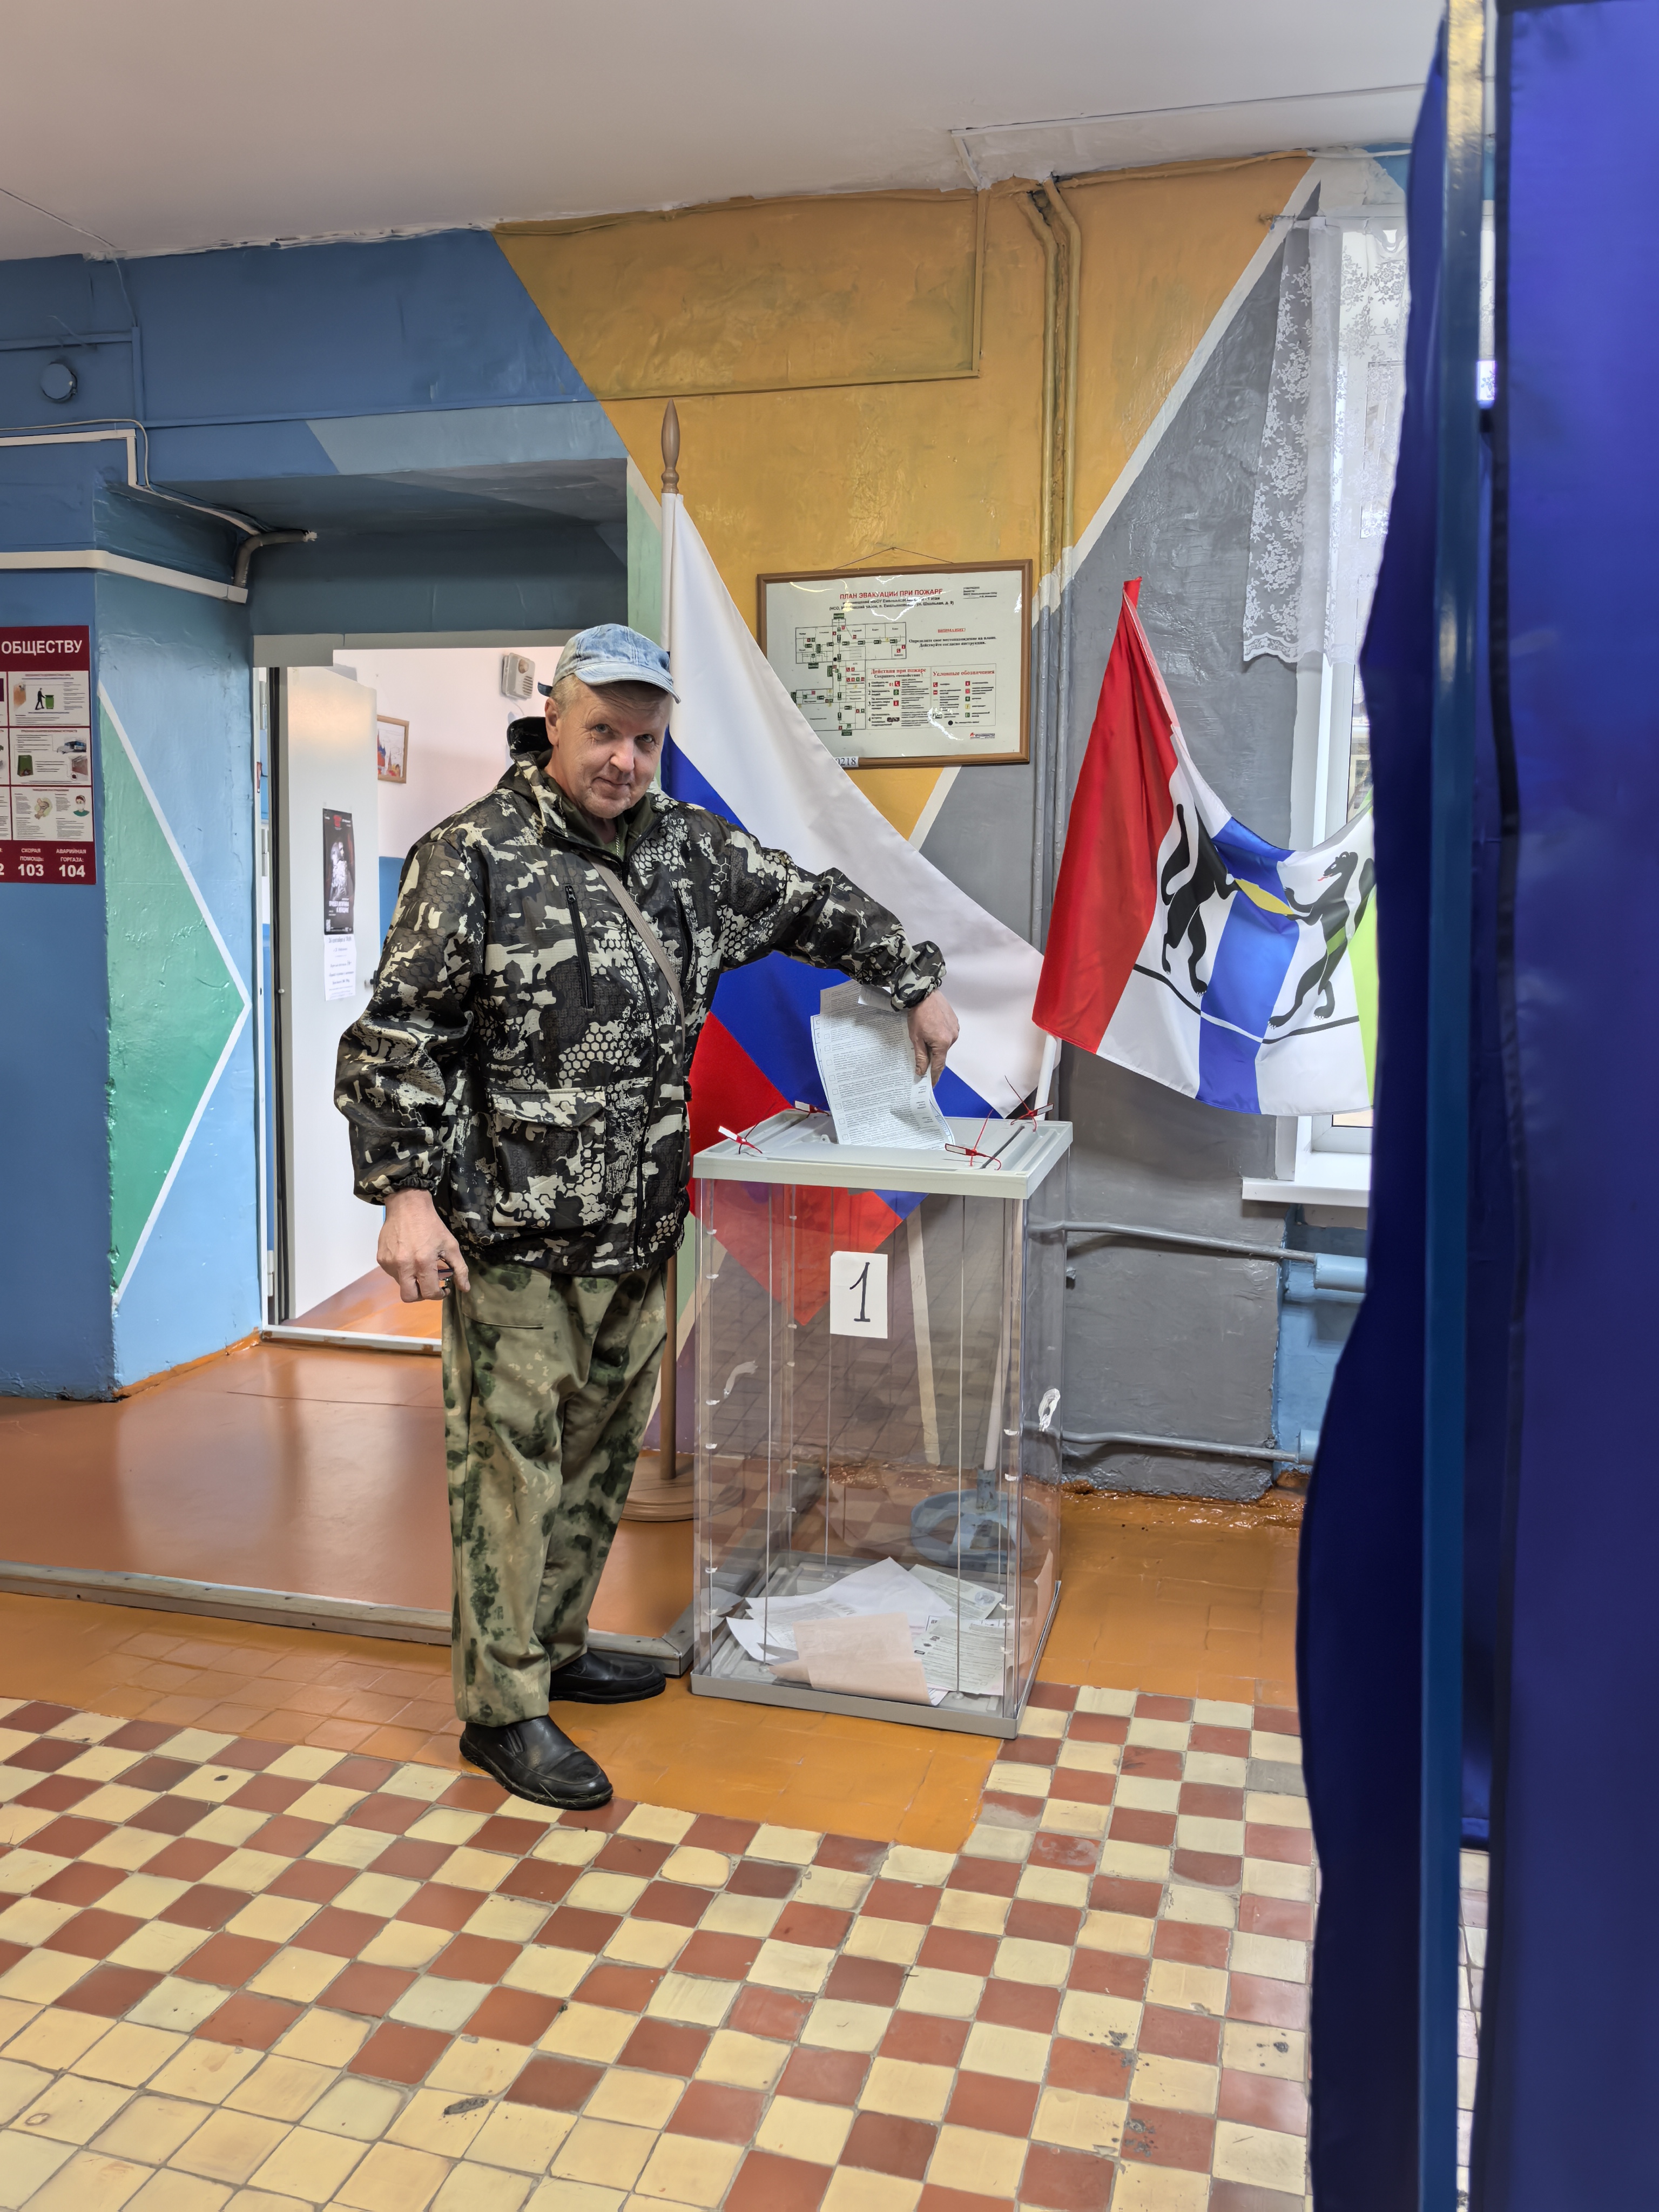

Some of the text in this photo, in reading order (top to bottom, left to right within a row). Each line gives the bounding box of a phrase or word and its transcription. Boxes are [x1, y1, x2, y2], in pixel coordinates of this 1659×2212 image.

[2, 640, 82, 656] ОБЩЕСТВУ
[18, 864, 44, 876] 103
[59, 865, 86, 877] 104
[849, 1262, 871, 1322] 1
